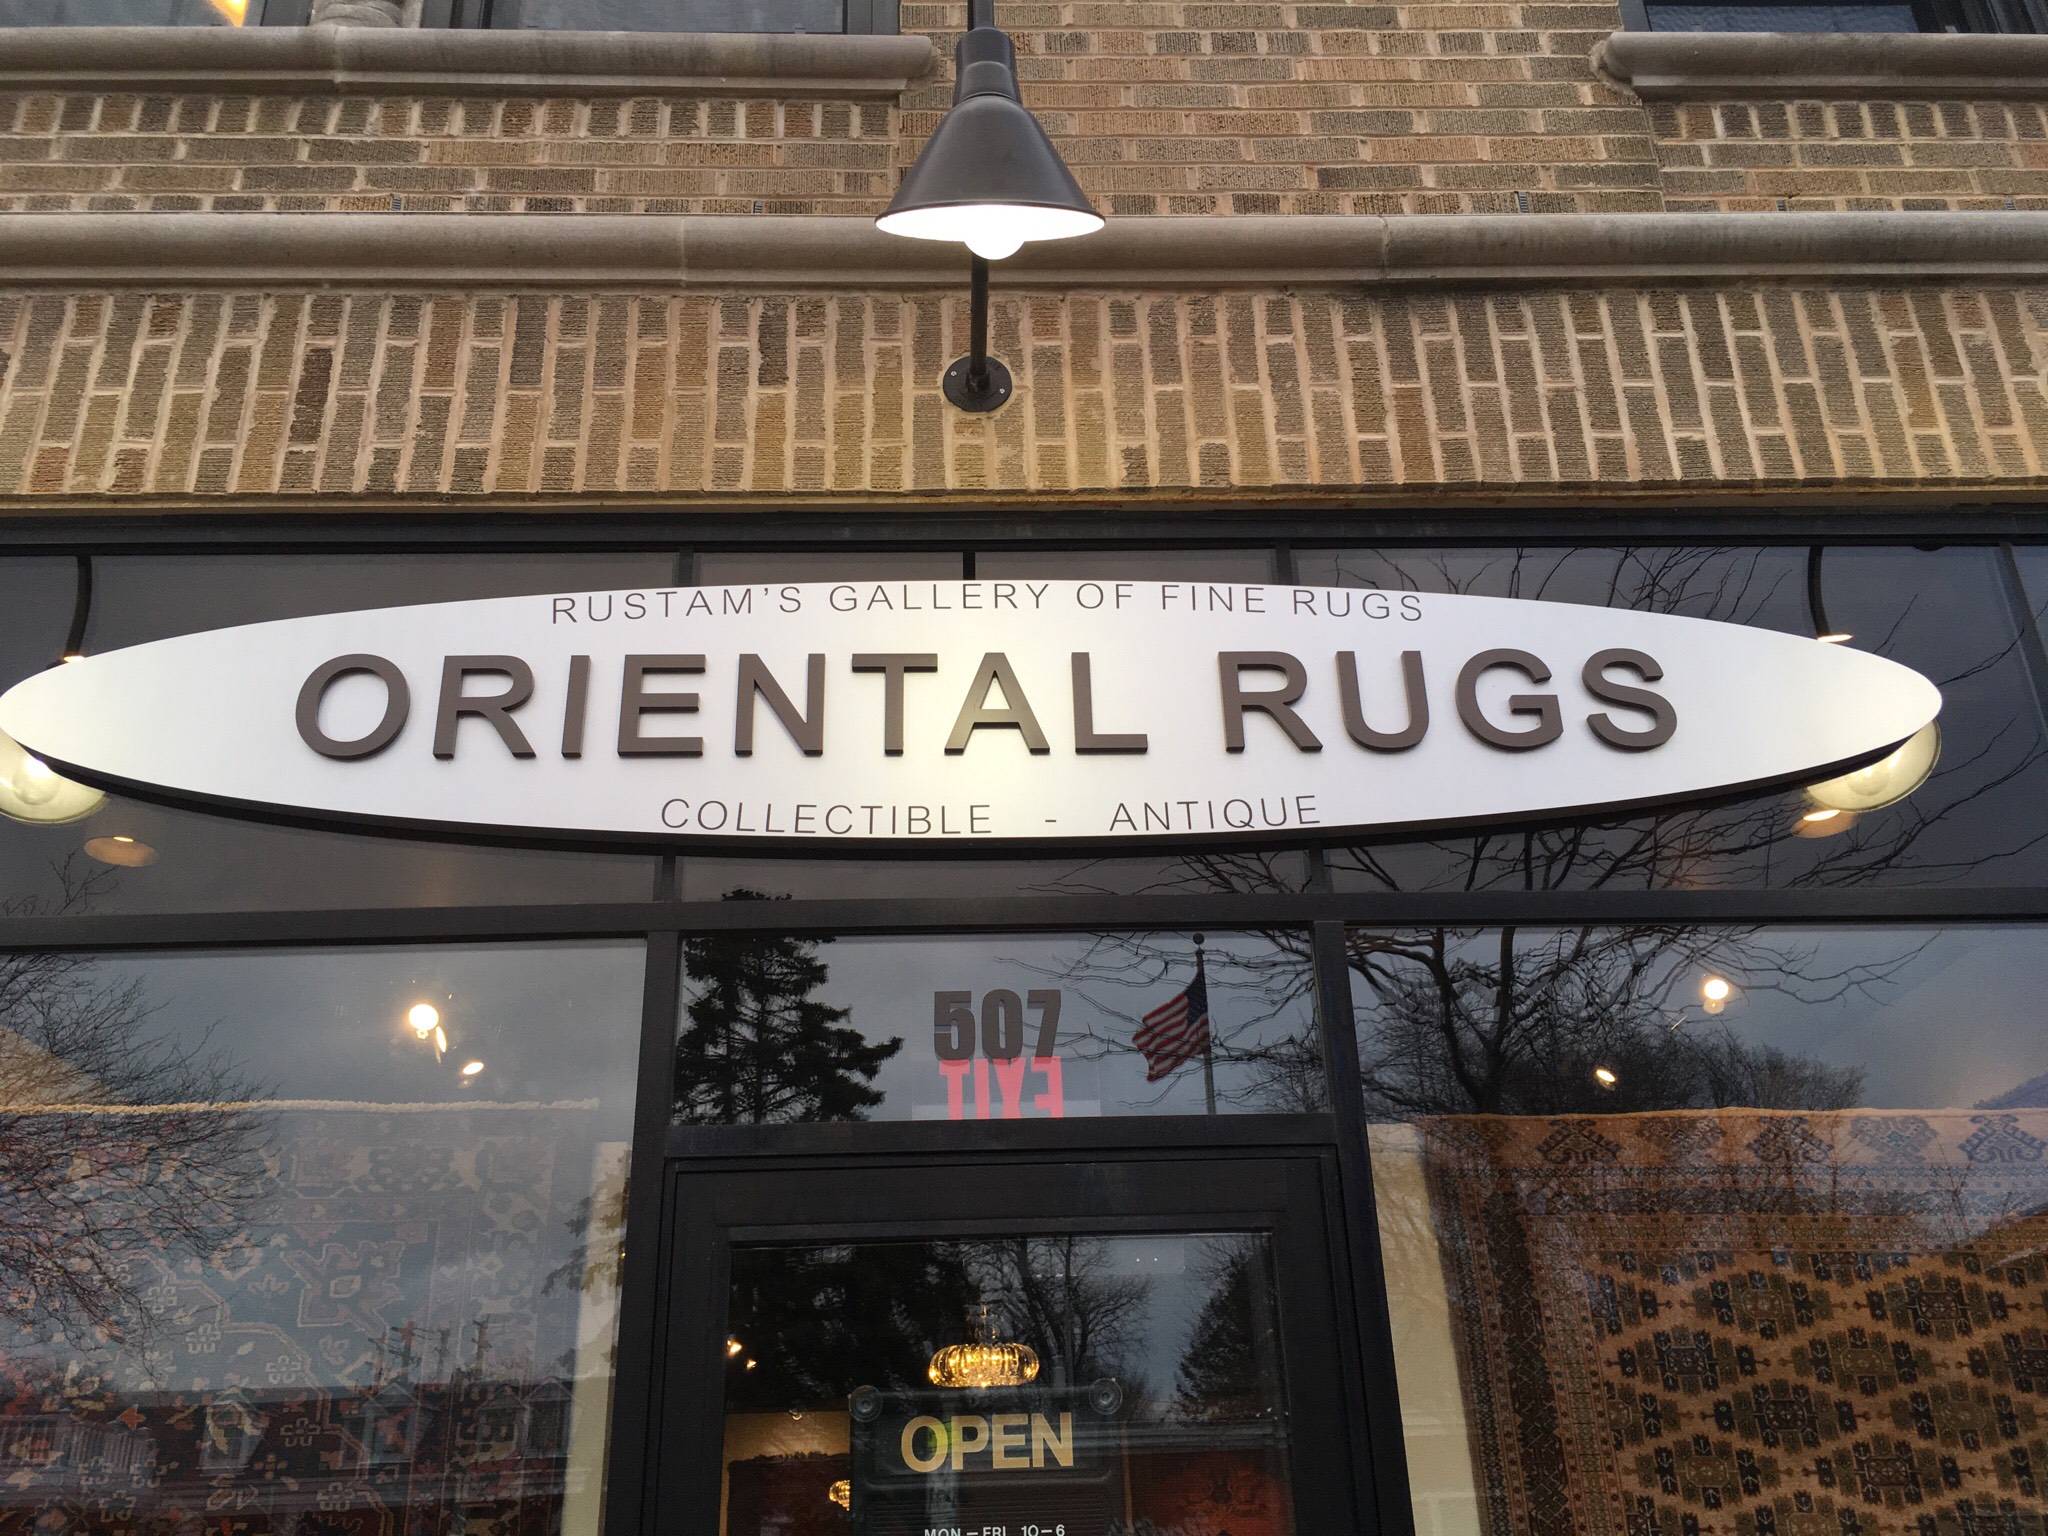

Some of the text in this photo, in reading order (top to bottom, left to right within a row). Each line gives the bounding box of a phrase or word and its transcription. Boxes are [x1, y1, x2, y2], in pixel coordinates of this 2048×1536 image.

[552, 582, 1422, 625] RUSTAM'S GALLERY OF FINE RUGS
[295, 647, 1678, 762] ORIENTAL RUGS
[661, 798, 992, 835] COLLECTIBLE
[1109, 795, 1321, 832] ANTIQUE
[933, 988, 1062, 1062] 507
[901, 1411, 1074, 1473] OPEN
